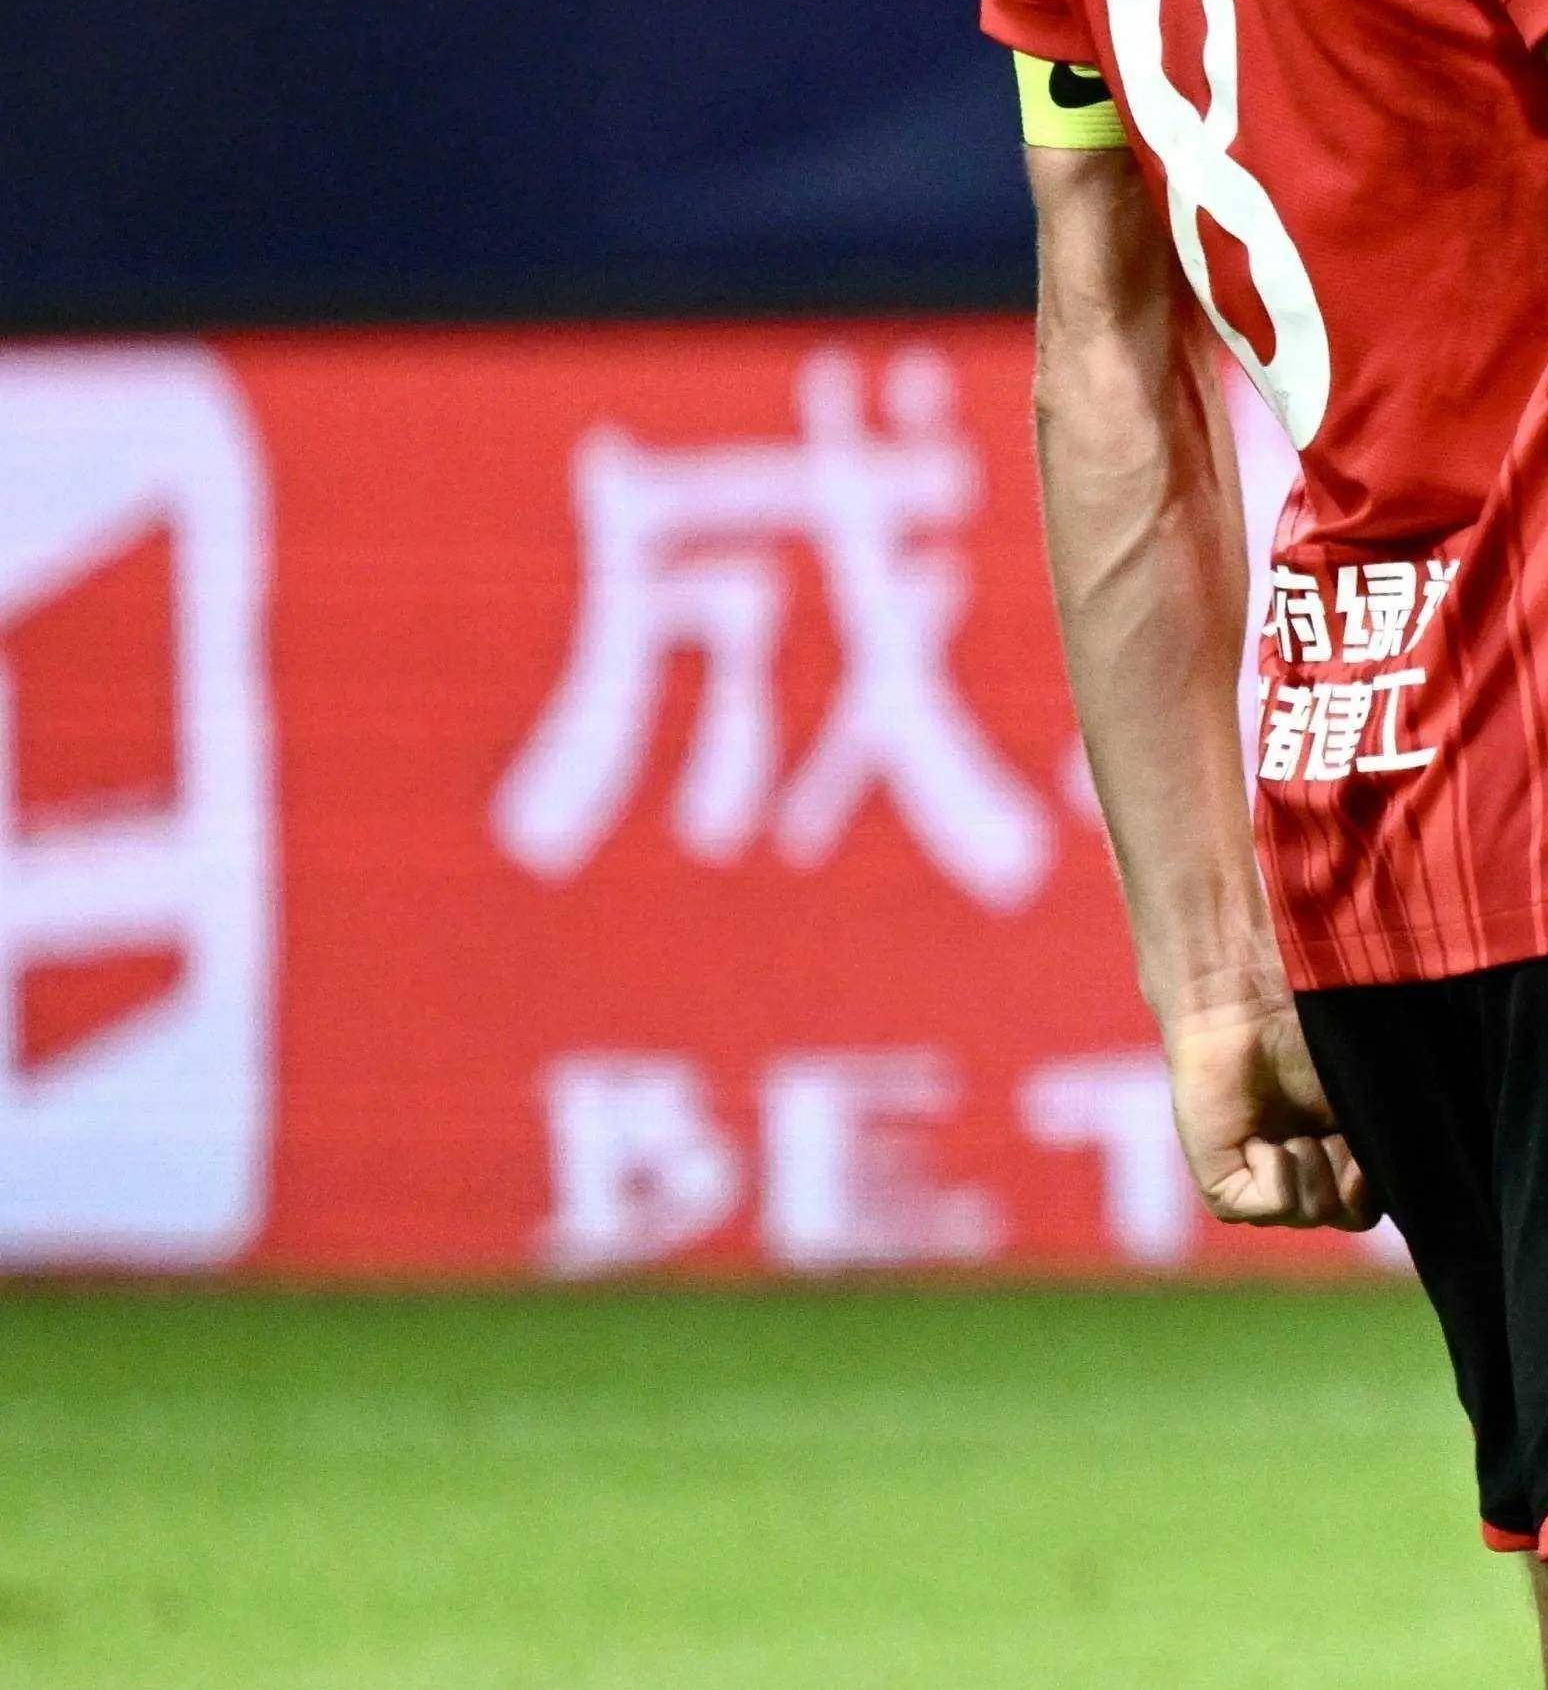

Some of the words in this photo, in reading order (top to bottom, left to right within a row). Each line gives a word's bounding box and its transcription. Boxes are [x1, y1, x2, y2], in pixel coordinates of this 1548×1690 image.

[1261, 557, 1462, 664] 府绿
[1258, 668, 1440, 782] 都建工
